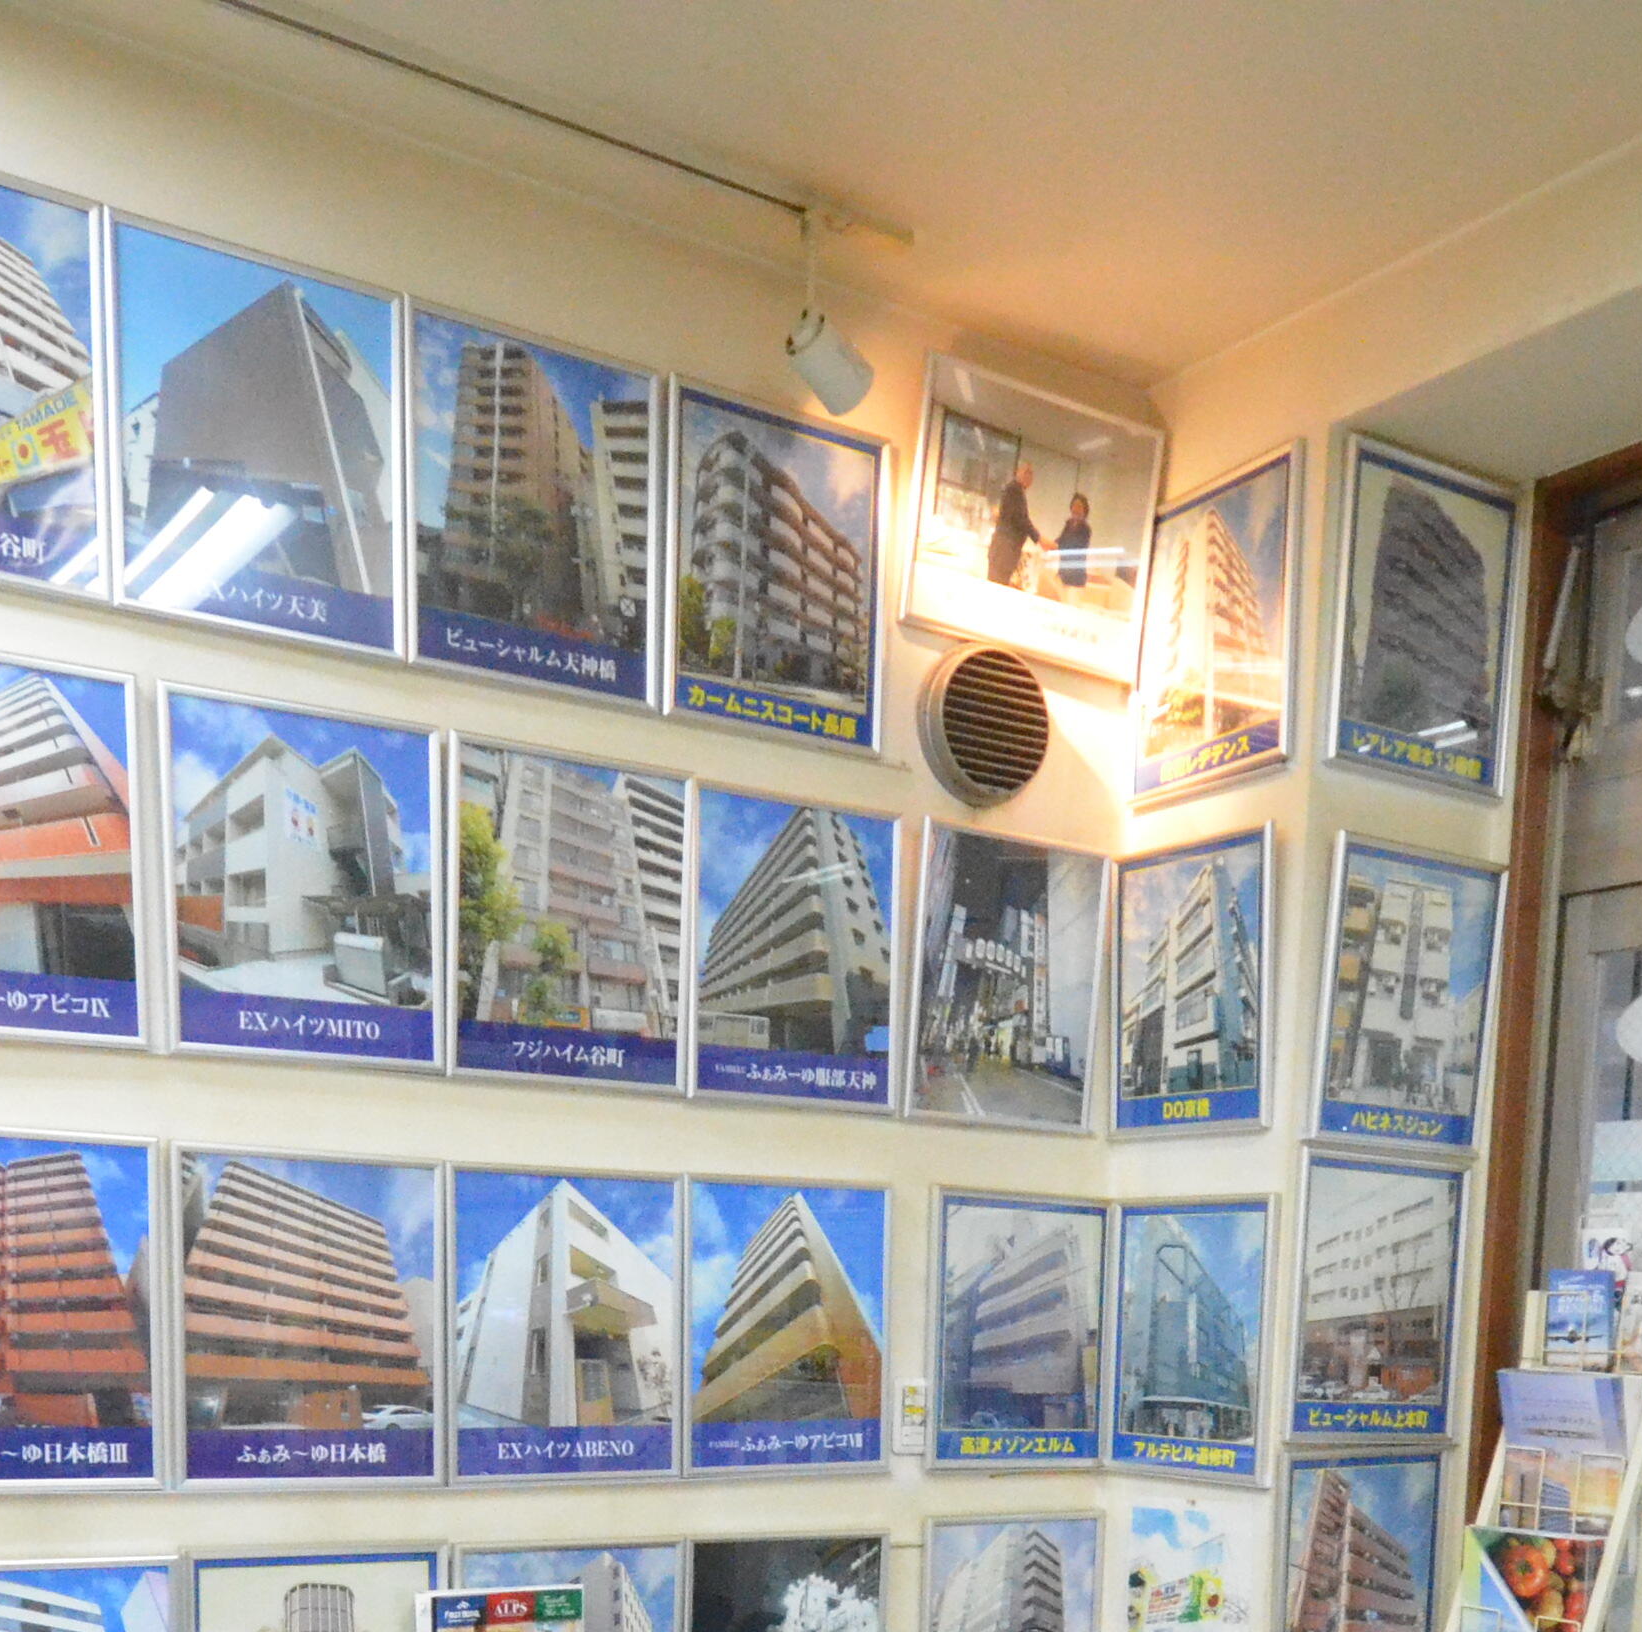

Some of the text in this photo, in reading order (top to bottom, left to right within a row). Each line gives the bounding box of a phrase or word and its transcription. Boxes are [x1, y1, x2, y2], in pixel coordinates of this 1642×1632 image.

[239, 1009, 380, 1042] EXハイツMITO
[497, 1439, 635, 1462] EXハイツABENO
